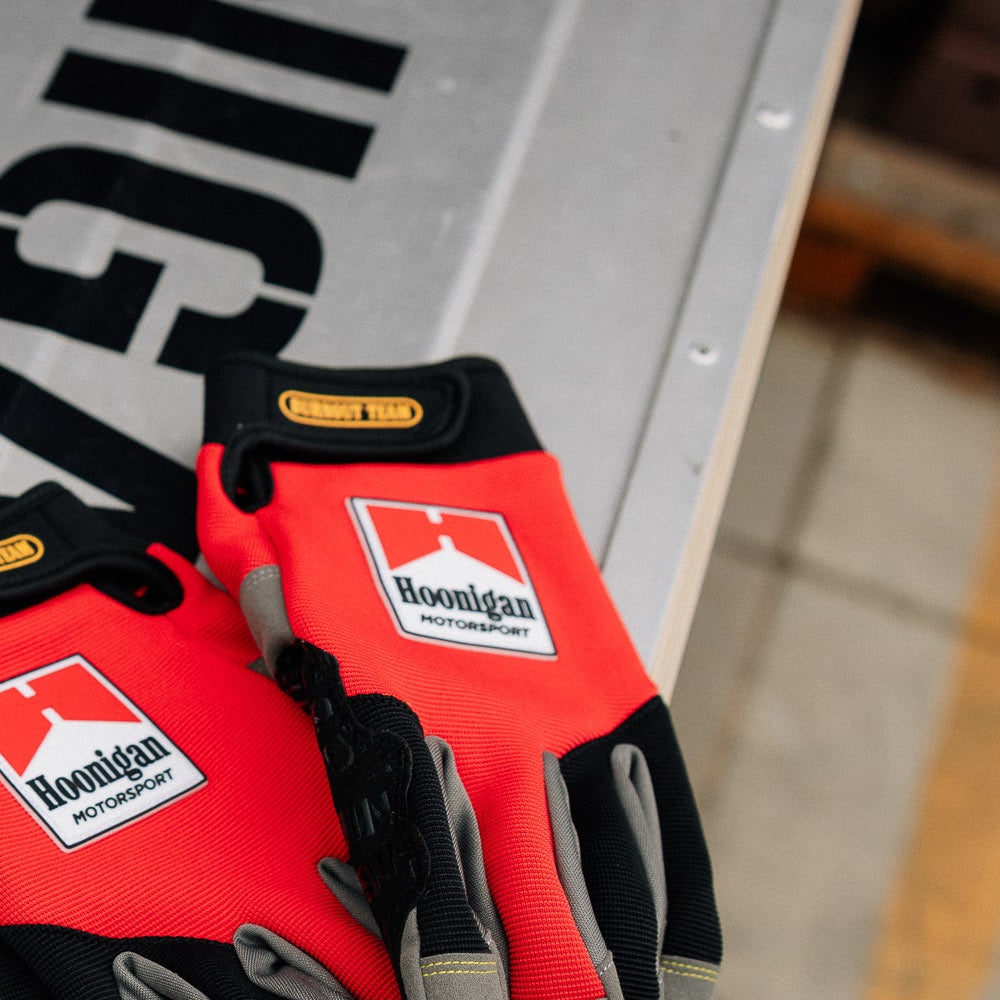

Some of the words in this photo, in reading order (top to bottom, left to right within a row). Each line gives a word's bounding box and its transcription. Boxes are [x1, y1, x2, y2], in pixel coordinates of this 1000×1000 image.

[393, 576, 536, 621] Hoonigan
[420, 613, 530, 638] MOTORSPORT
[25, 735, 172, 811] Hoonigan
[72, 768, 175, 825] MOTORSPORT
